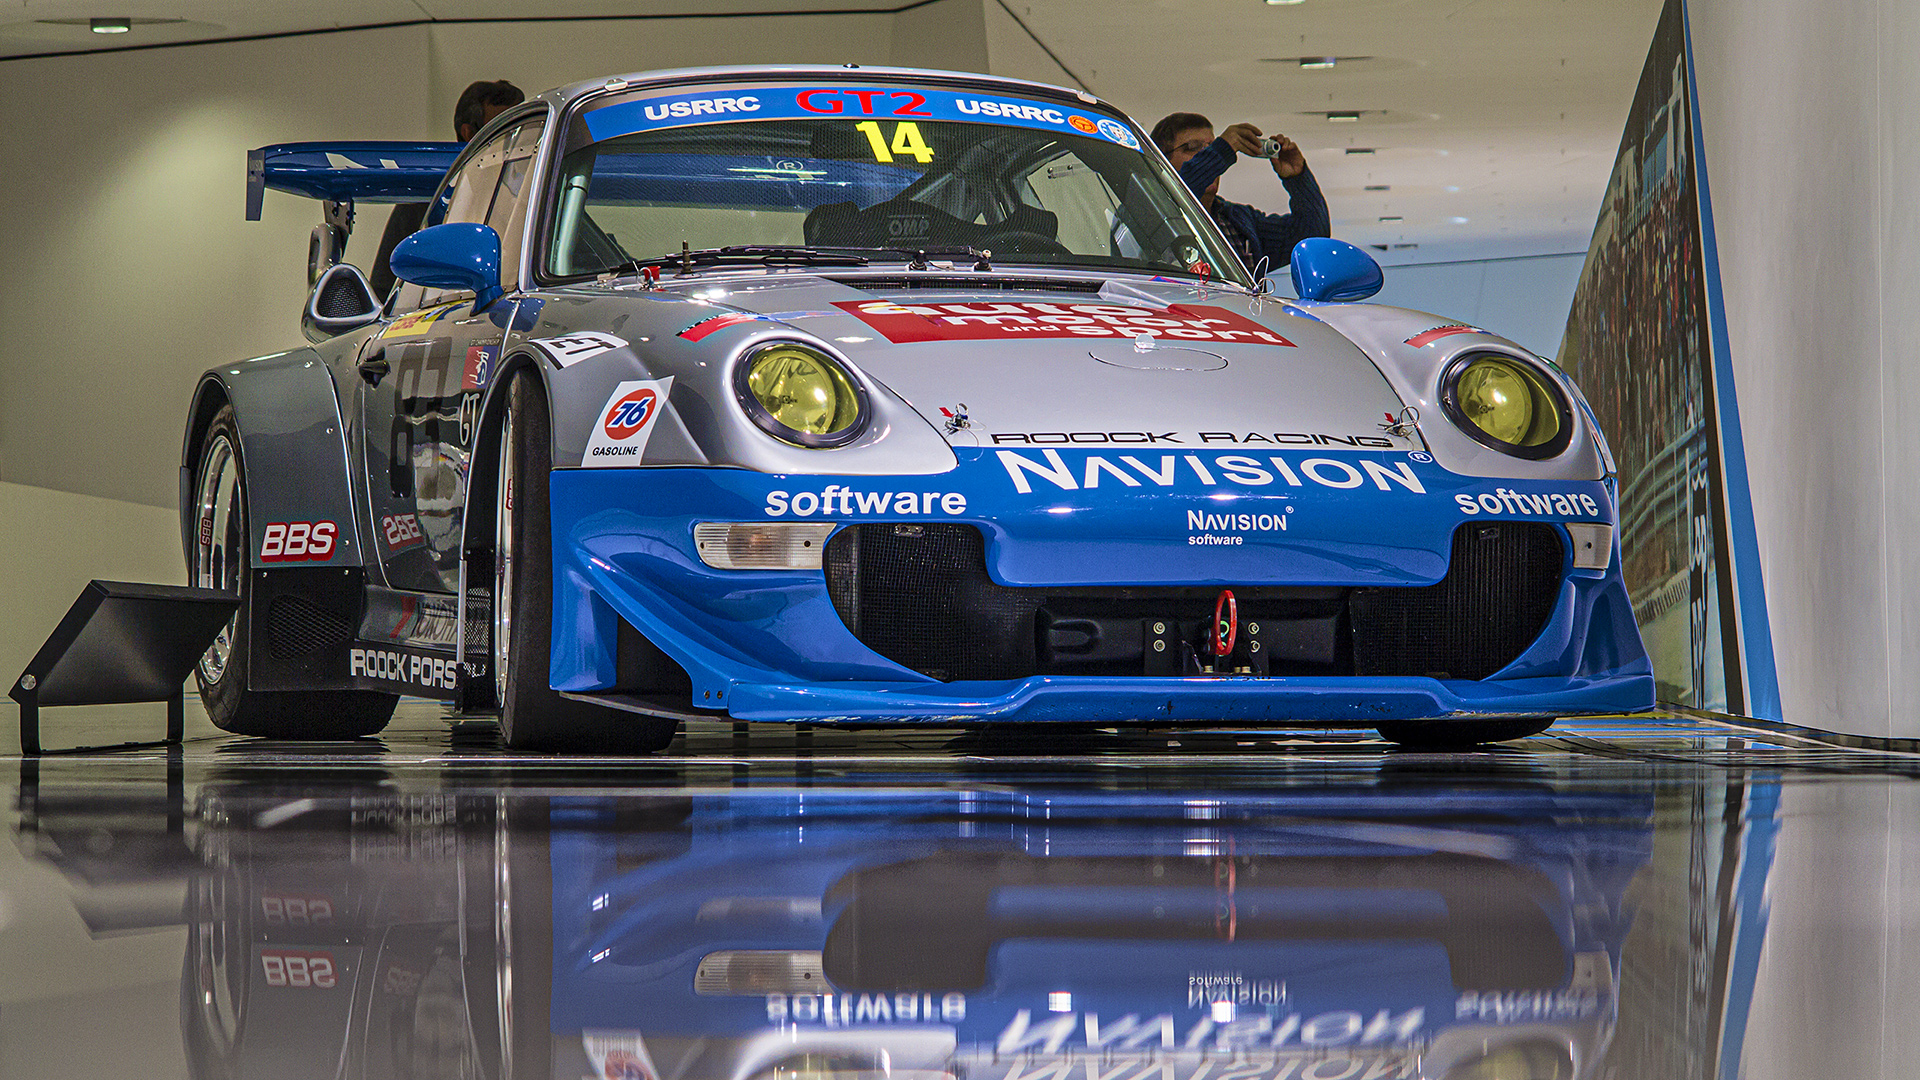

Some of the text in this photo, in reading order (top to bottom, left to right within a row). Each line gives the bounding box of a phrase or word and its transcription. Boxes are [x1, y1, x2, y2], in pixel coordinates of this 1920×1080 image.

[643, 96, 761, 121] USRRC
[796, 89, 932, 116] GT2
[955, 98, 1065, 124] USRRC
[855, 121, 935, 163] 14
[889, 219, 930, 237] OMP
[858, 302, 1154, 317] auto
[941, 314, 1230, 329] motor
[1002, 324, 1283, 343] und sport
[607, 396, 655, 428] 76
[592, 446, 639, 456] GASOLINE
[990, 432, 1394, 447] ROOCK RACING
[764, 484, 967, 516] software
[1454, 488, 1599, 517] software
[260, 521, 338, 560] BBS
[1188, 533, 1243, 545] software
[350, 648, 407, 682] ROOCK
